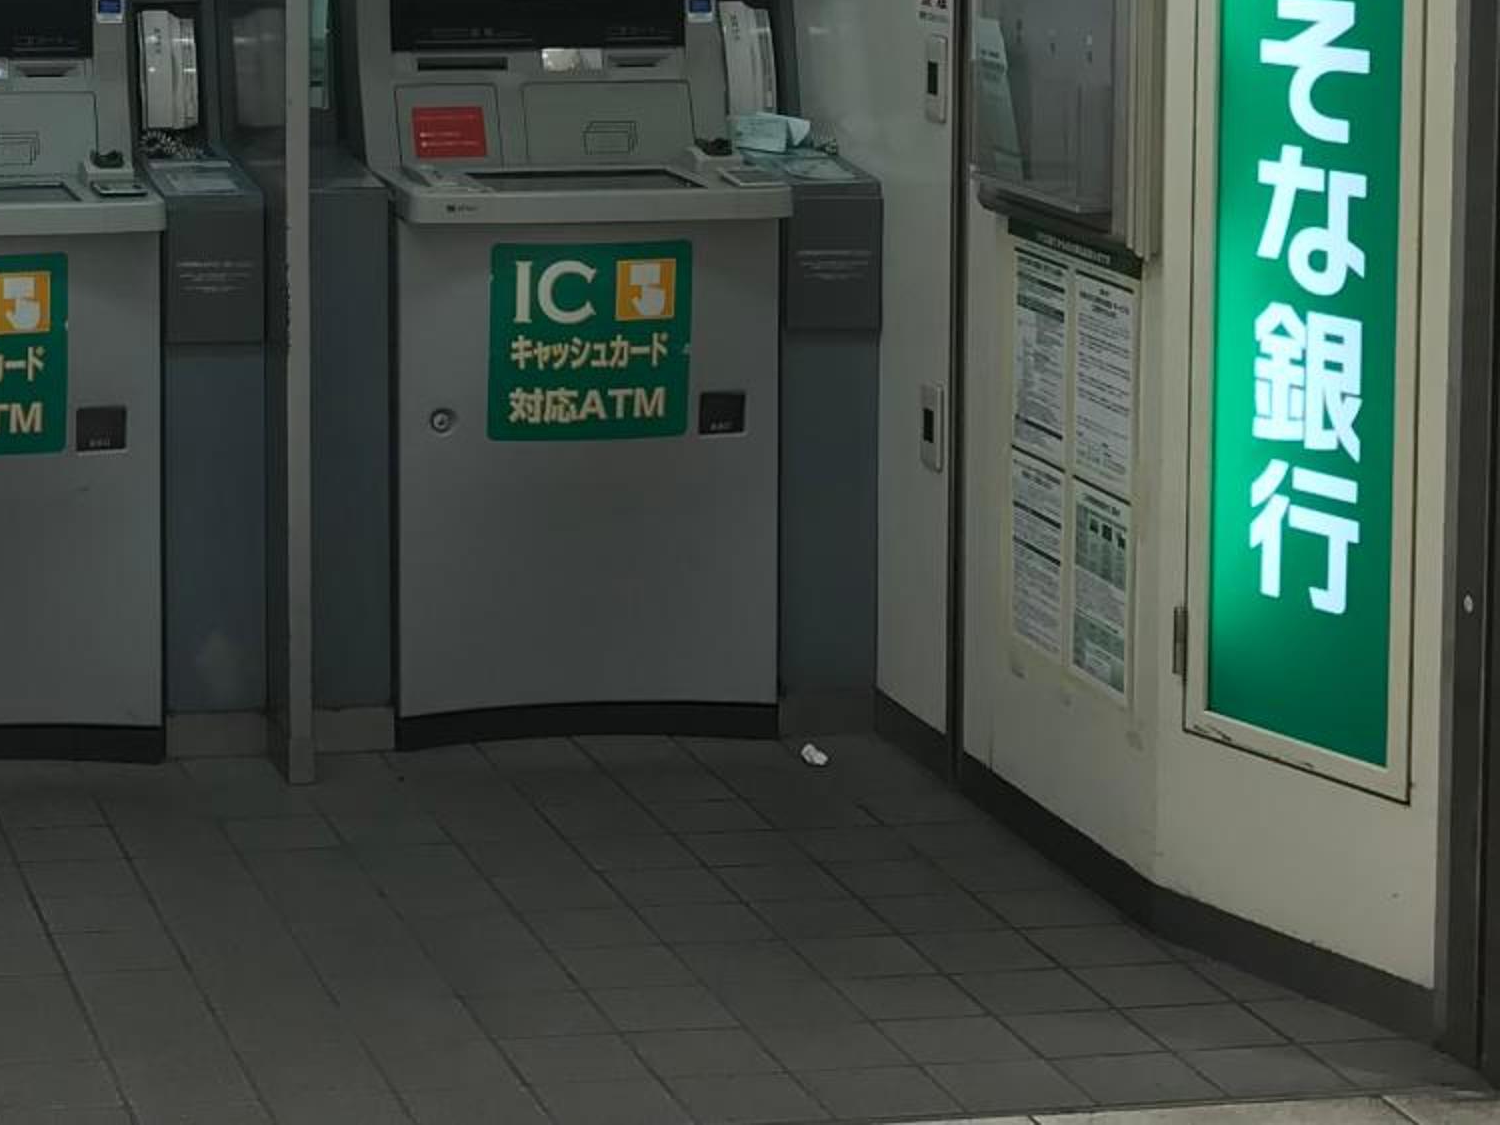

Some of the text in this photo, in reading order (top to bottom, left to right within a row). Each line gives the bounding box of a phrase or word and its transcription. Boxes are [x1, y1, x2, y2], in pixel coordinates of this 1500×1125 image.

[513, 260, 597, 325] IC
[509, 331, 670, 371] キャッシュカード
[507, 386, 667, 426] 対応ATM
